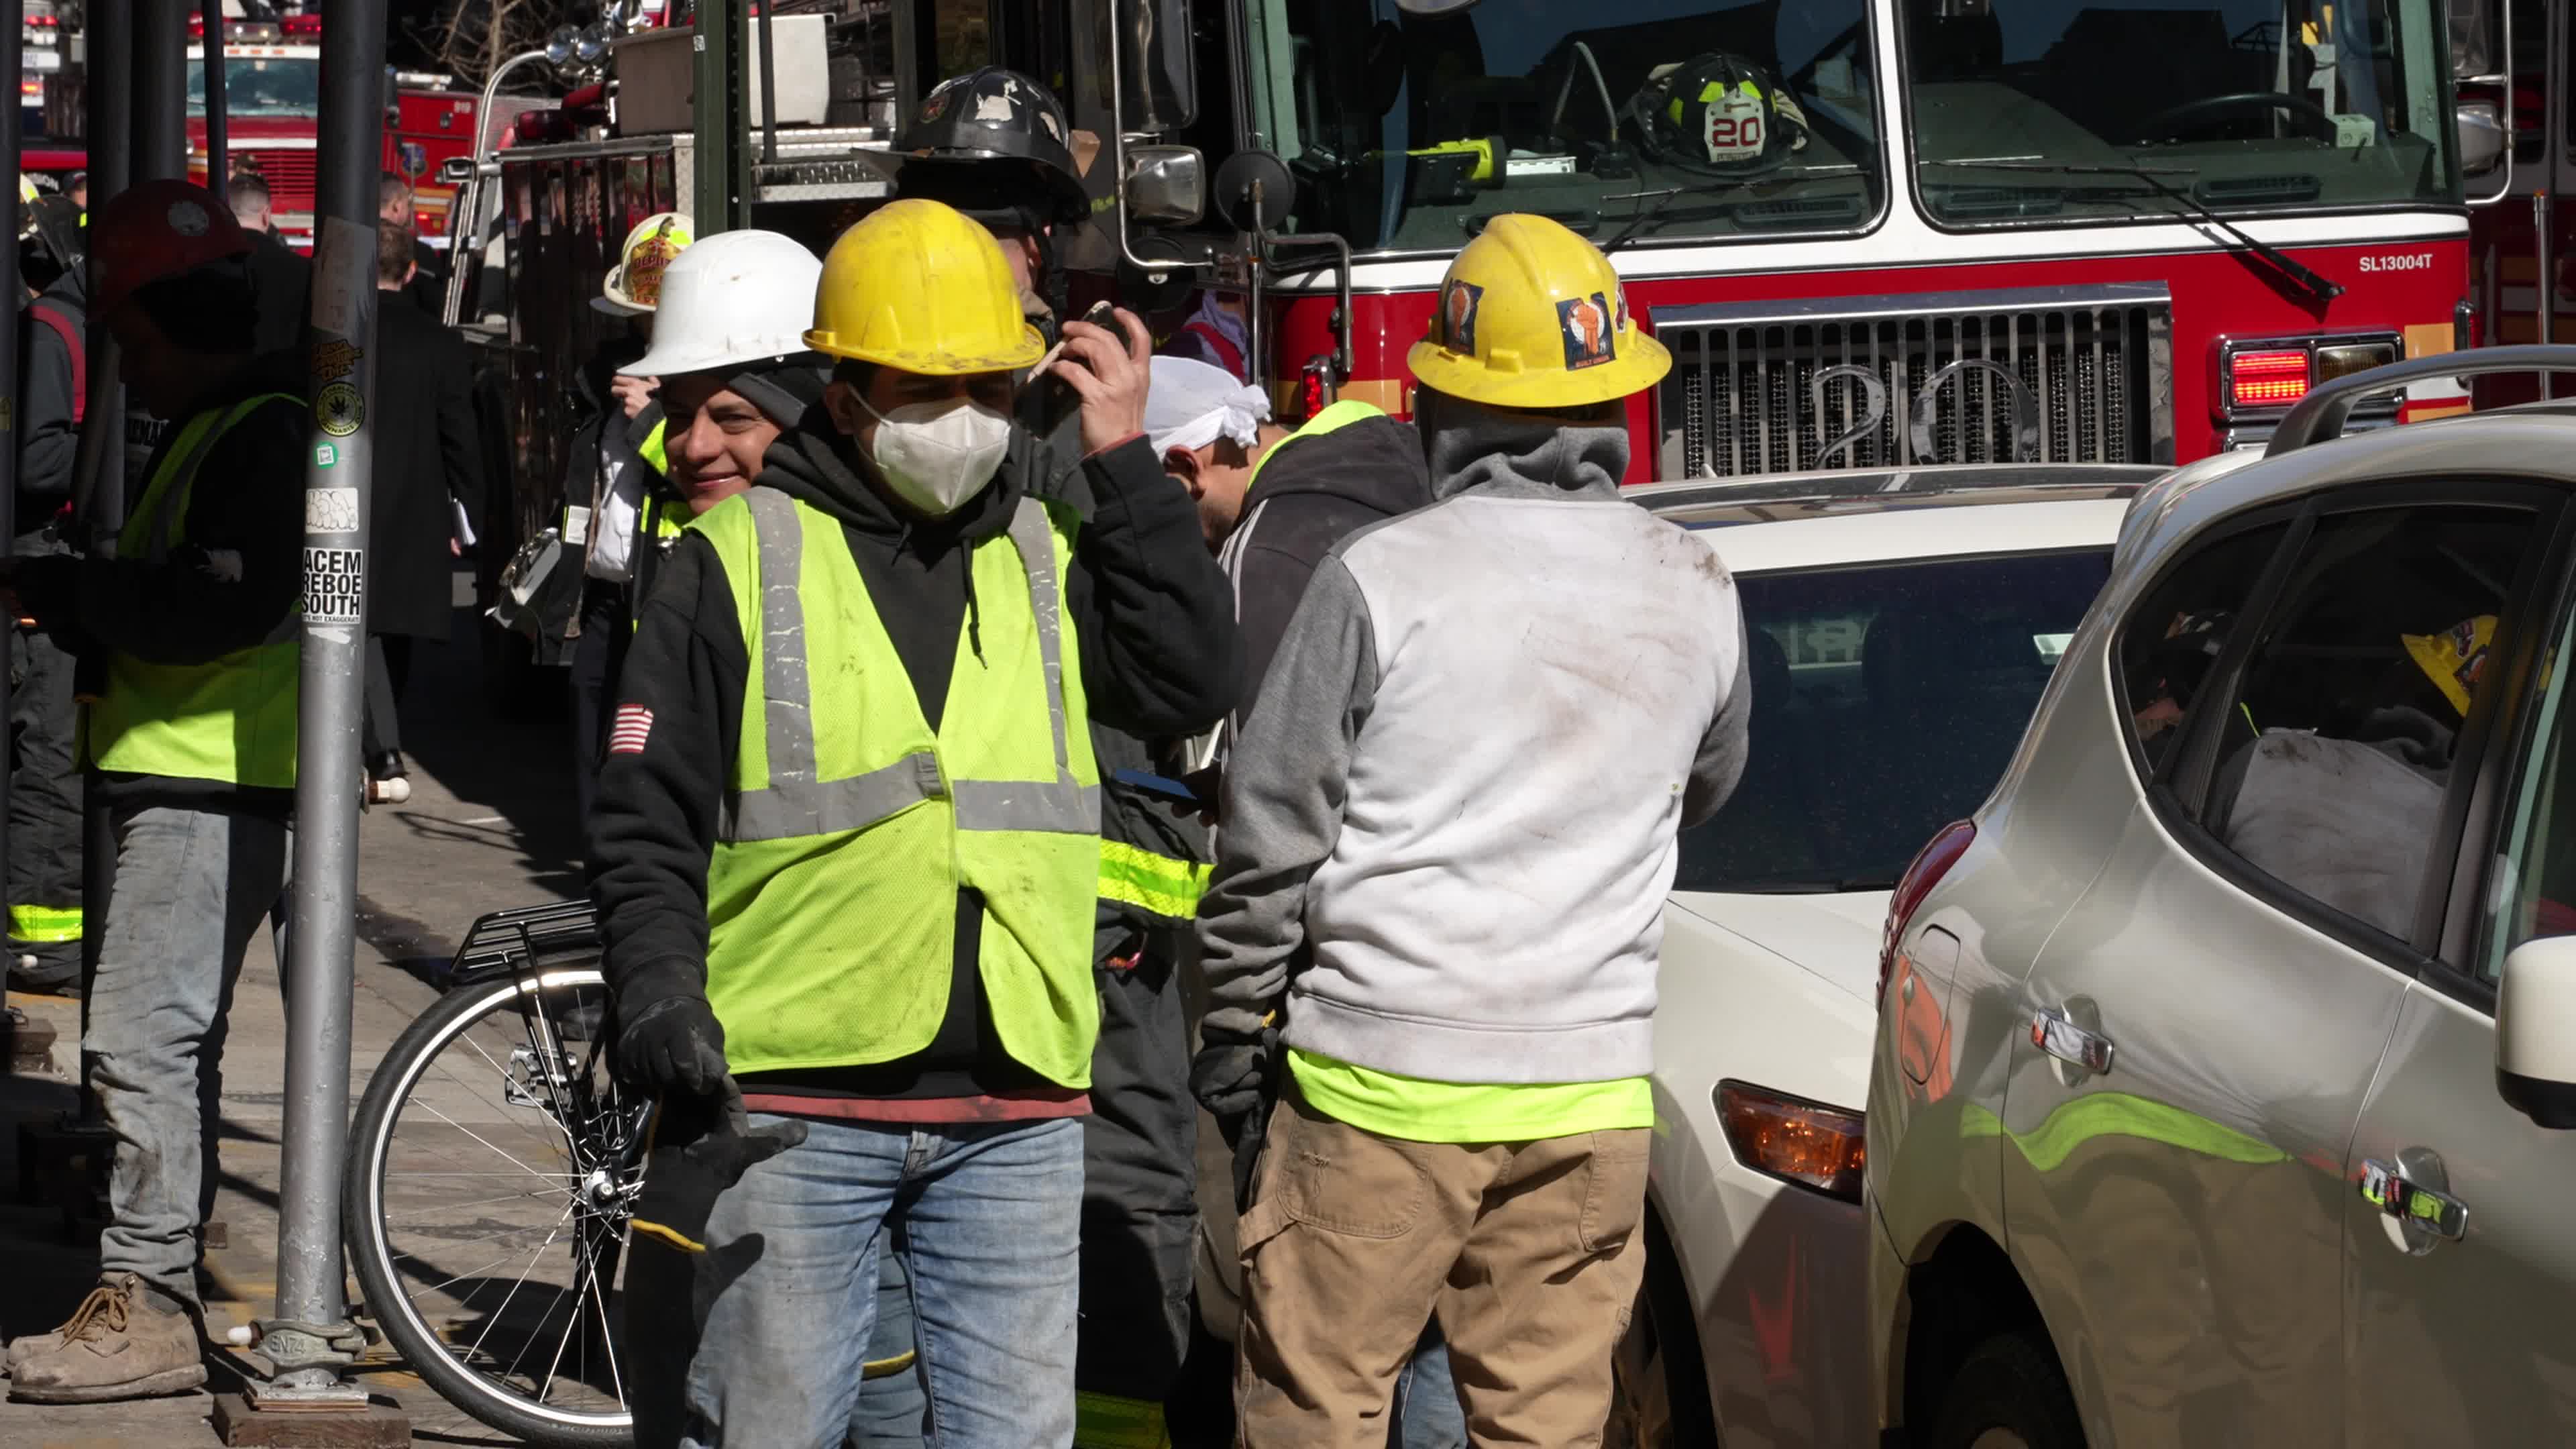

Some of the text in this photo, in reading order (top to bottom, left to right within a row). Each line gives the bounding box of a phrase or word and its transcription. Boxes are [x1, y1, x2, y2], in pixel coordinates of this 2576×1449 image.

[1713, 117, 1760, 146] 20
[2359, 254, 2433, 272] SL13004T
[301, 592, 360, 615] SOUTH
